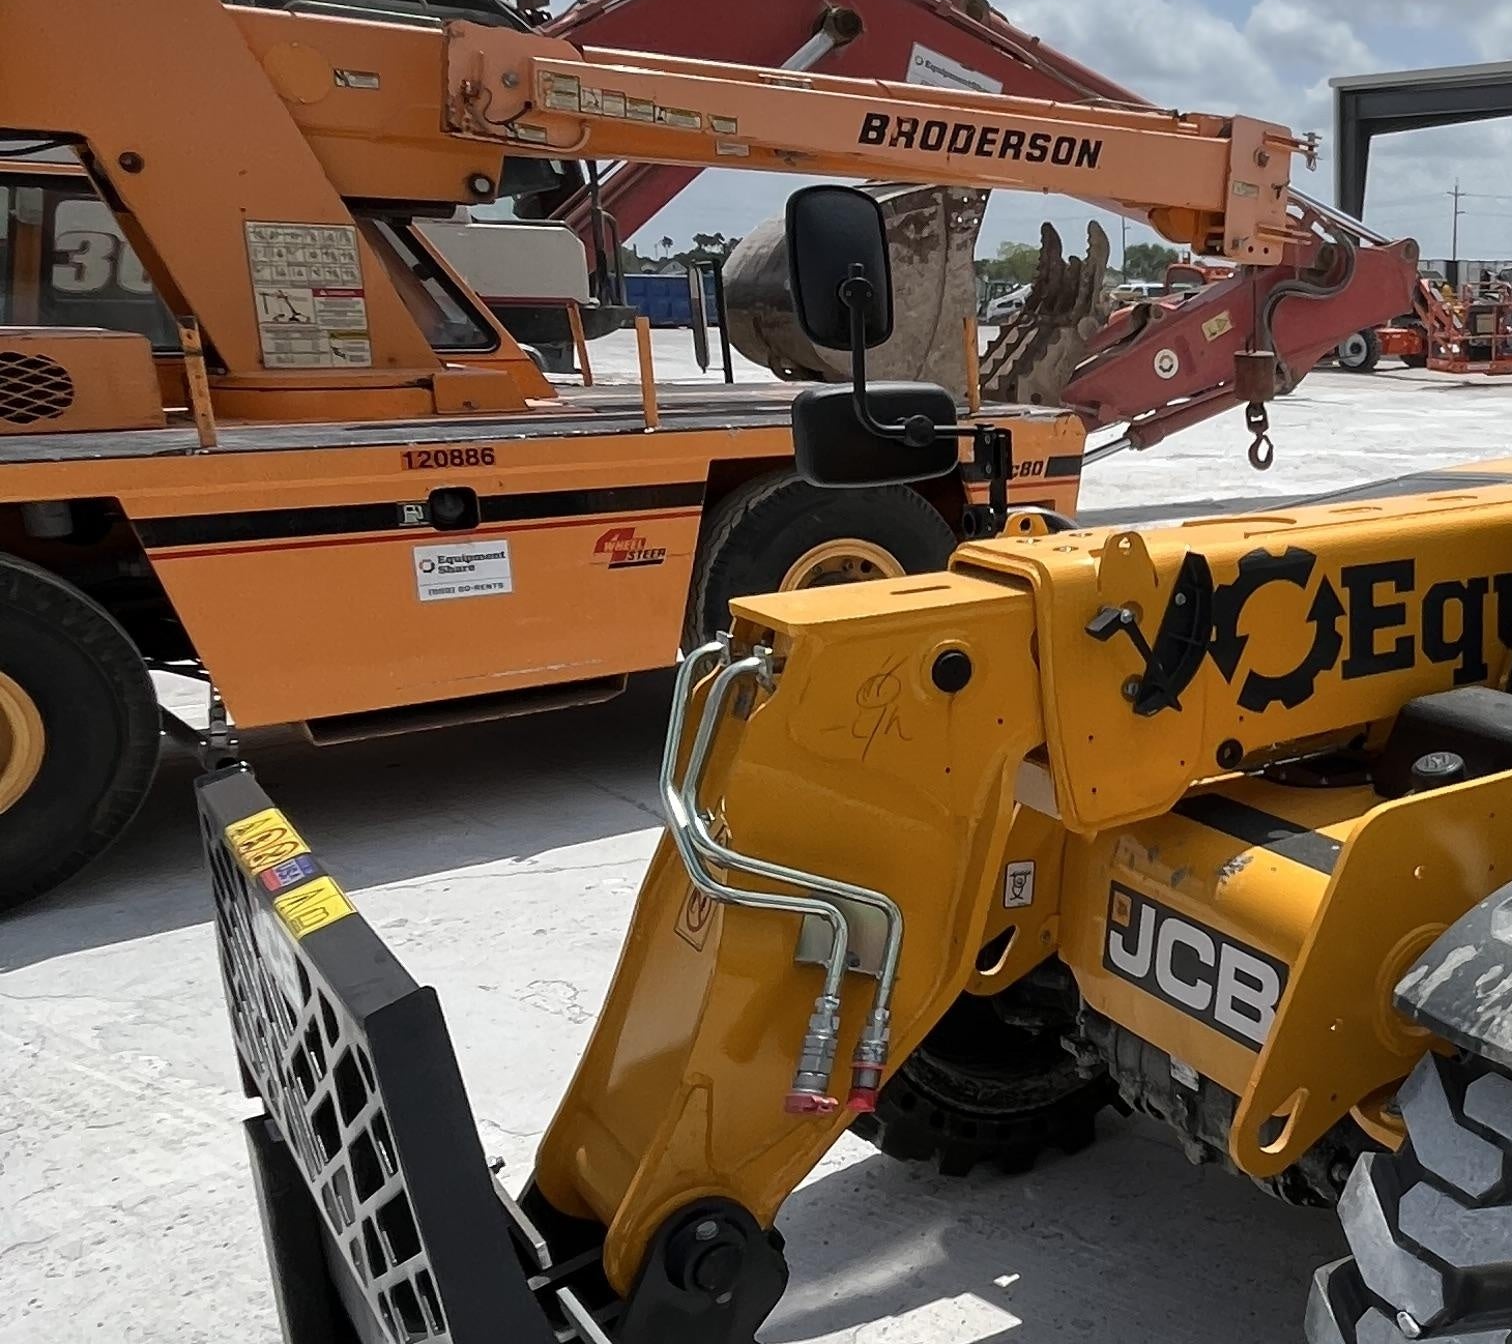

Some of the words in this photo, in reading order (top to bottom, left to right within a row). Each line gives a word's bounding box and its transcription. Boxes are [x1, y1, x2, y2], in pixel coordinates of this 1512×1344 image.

[858, 112, 1103, 169] BRODERSON
[402, 447, 495, 469] 120886
[603, 537, 647, 553] WHEEL
[437, 551, 506, 565] Equipment
[628, 547, 666, 561] STEER
[437, 564, 476, 574] Share
[1109, 903, 1280, 1045] JCB
